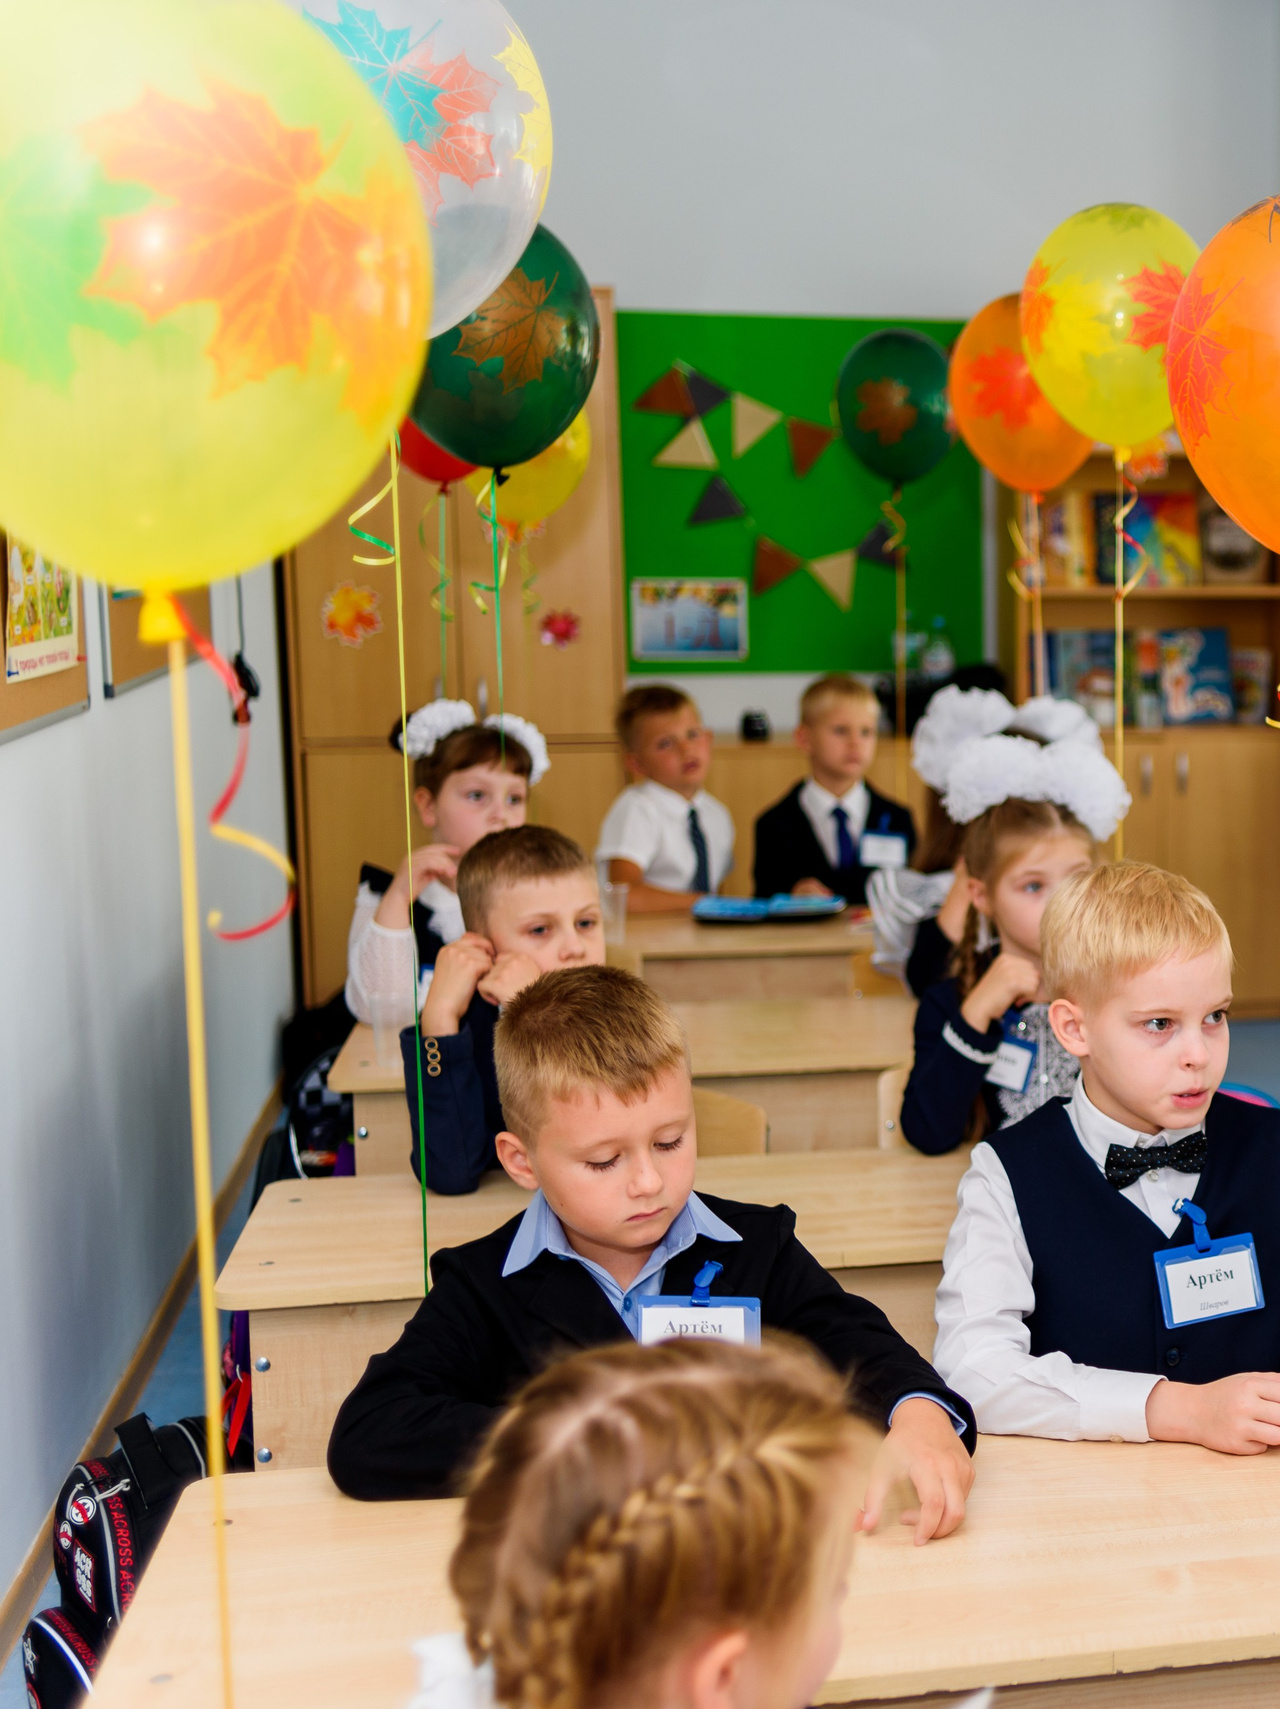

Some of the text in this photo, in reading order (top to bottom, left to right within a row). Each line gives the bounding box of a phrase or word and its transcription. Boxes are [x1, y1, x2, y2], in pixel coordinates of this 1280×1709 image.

[1186, 1268, 1235, 1290] Артём
[663, 1320, 723, 1337] Артём
[109, 1511, 134, 1567] ACROSS
[74, 1546, 92, 1578] ACR
